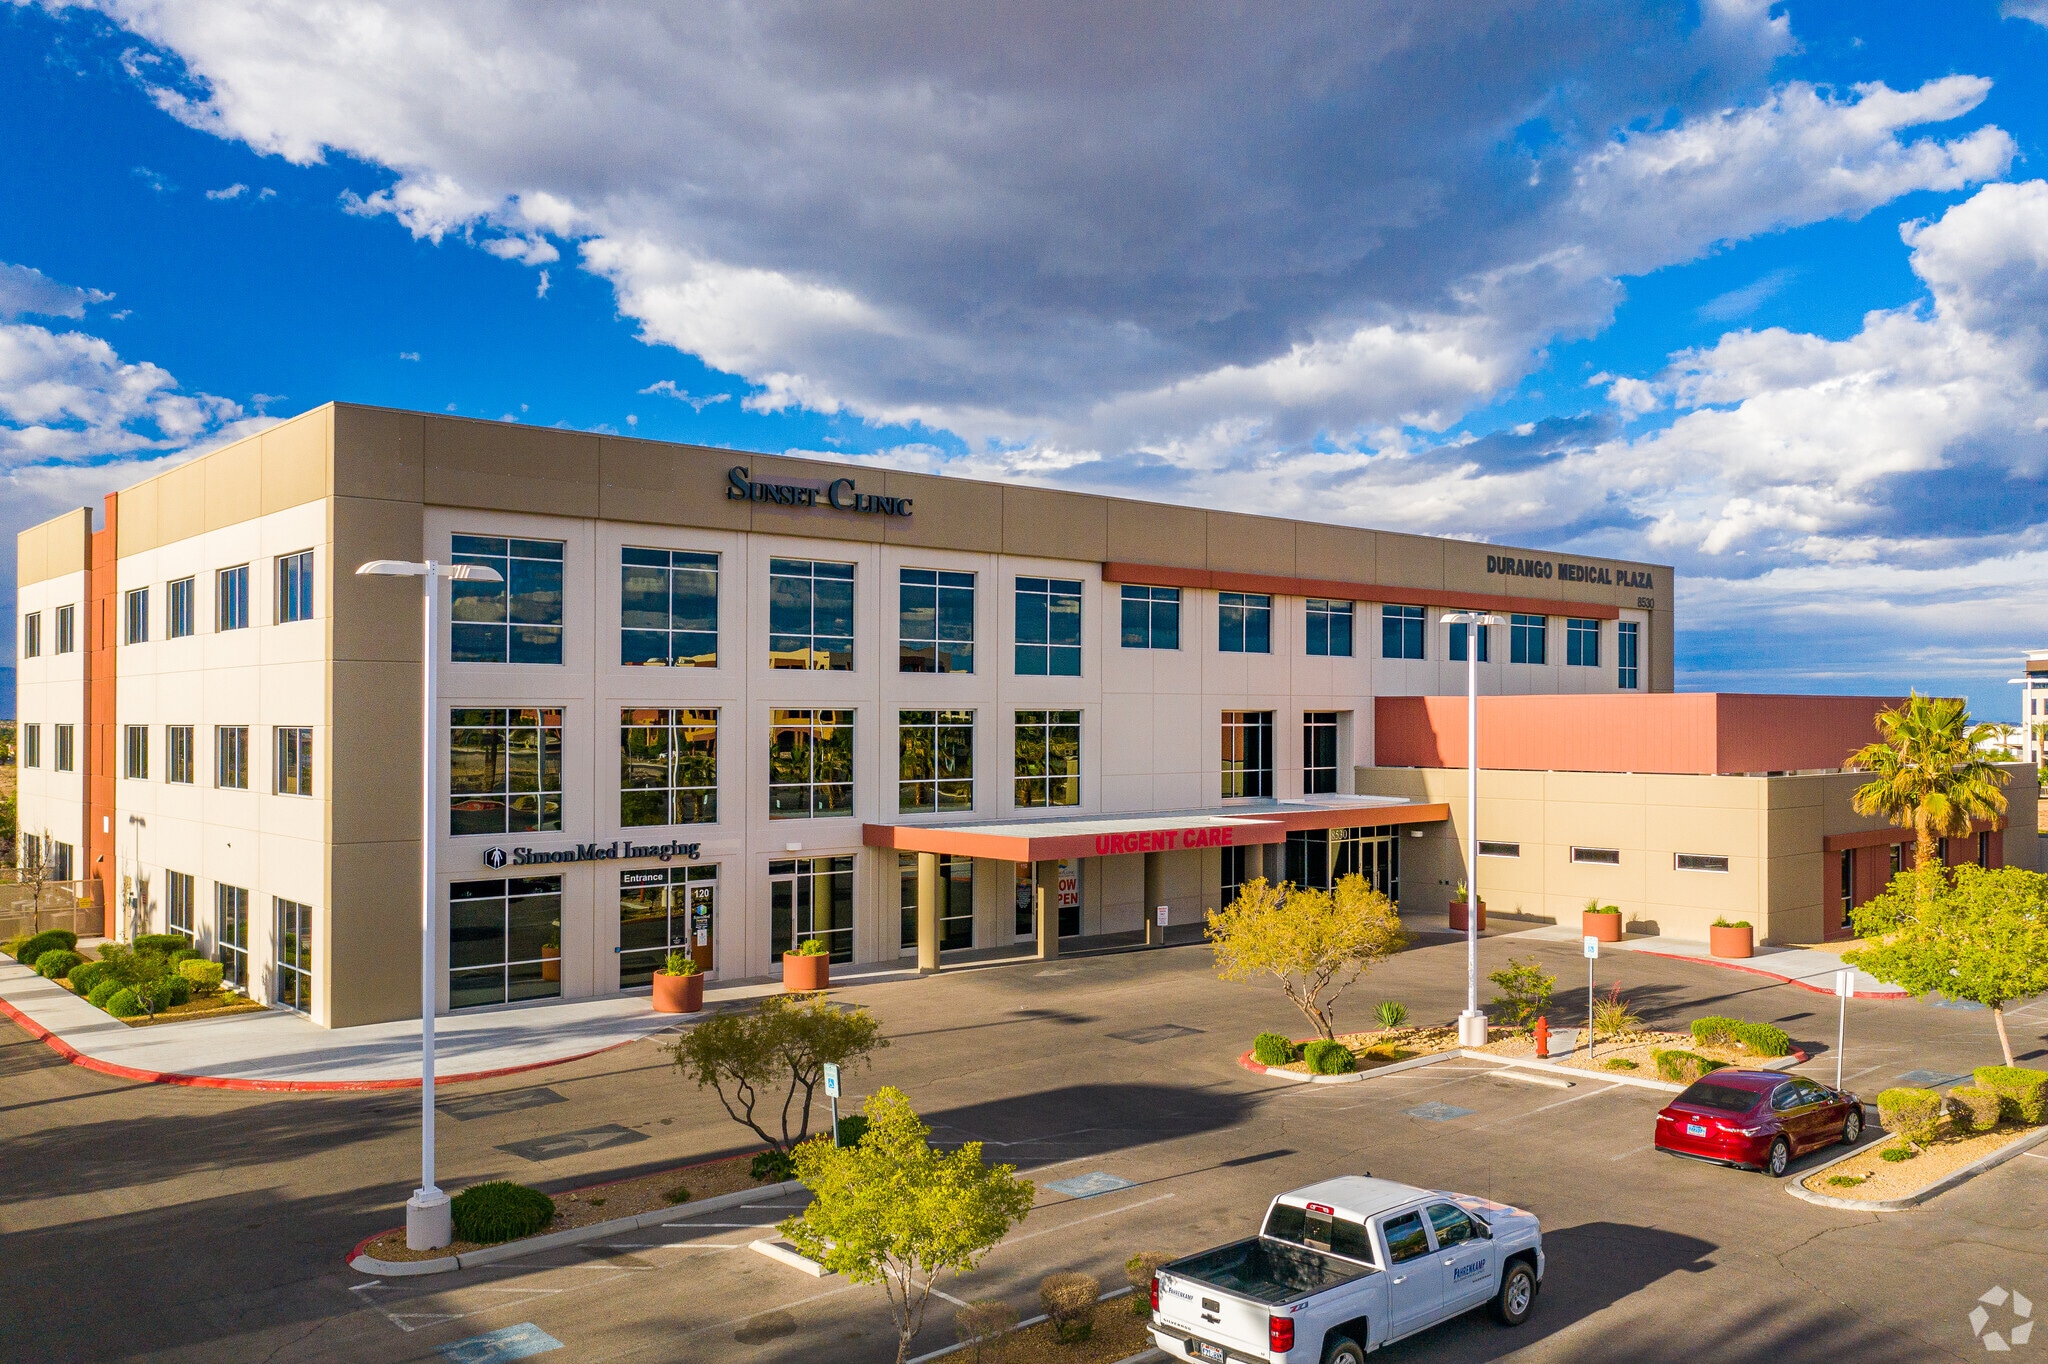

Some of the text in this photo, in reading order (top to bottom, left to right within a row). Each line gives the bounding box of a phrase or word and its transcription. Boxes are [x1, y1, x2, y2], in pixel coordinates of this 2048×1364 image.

[728, 466, 913, 516] SUNSET CLINIC
[1487, 555, 1654, 589] DURANGO MEDICAL PLAZA
[1637, 597, 1655, 609] 8530
[1095, 827, 1233, 855] URGENT CARE
[1331, 829, 1348, 840] 8530
[513, 840, 701, 865] SimonMed Imaging
[624, 873, 663, 884] Entrance
[1058, 878, 1077, 891] OW
[694, 888, 710, 898] 120
[1058, 892, 1079, 905] PEN
